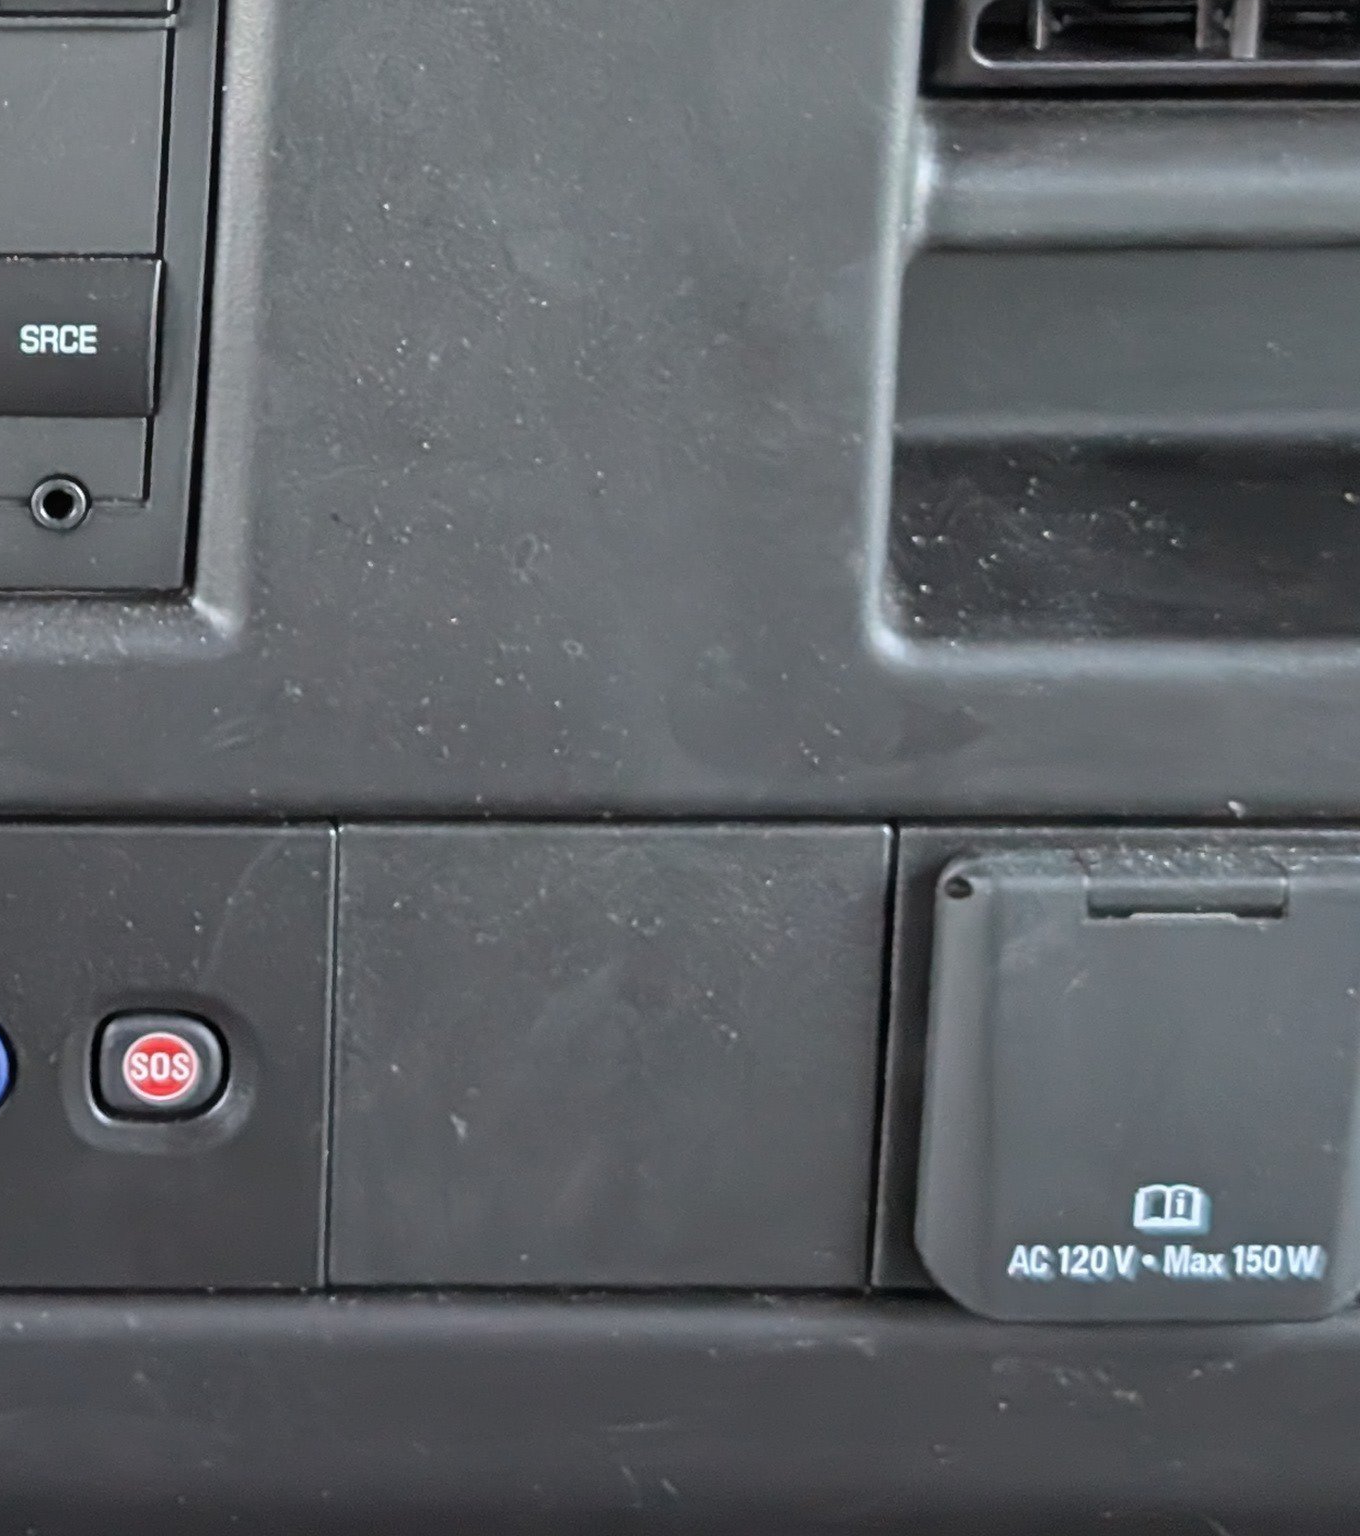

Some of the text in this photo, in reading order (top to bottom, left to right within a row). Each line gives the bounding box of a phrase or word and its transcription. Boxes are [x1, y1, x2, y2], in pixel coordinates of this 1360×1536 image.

[19, 324, 98, 354] SRCE
[129, 1051, 191, 1082] SOS
[1008, 1243, 1051, 1279] AC
[1162, 1243, 1227, 1278] Max
